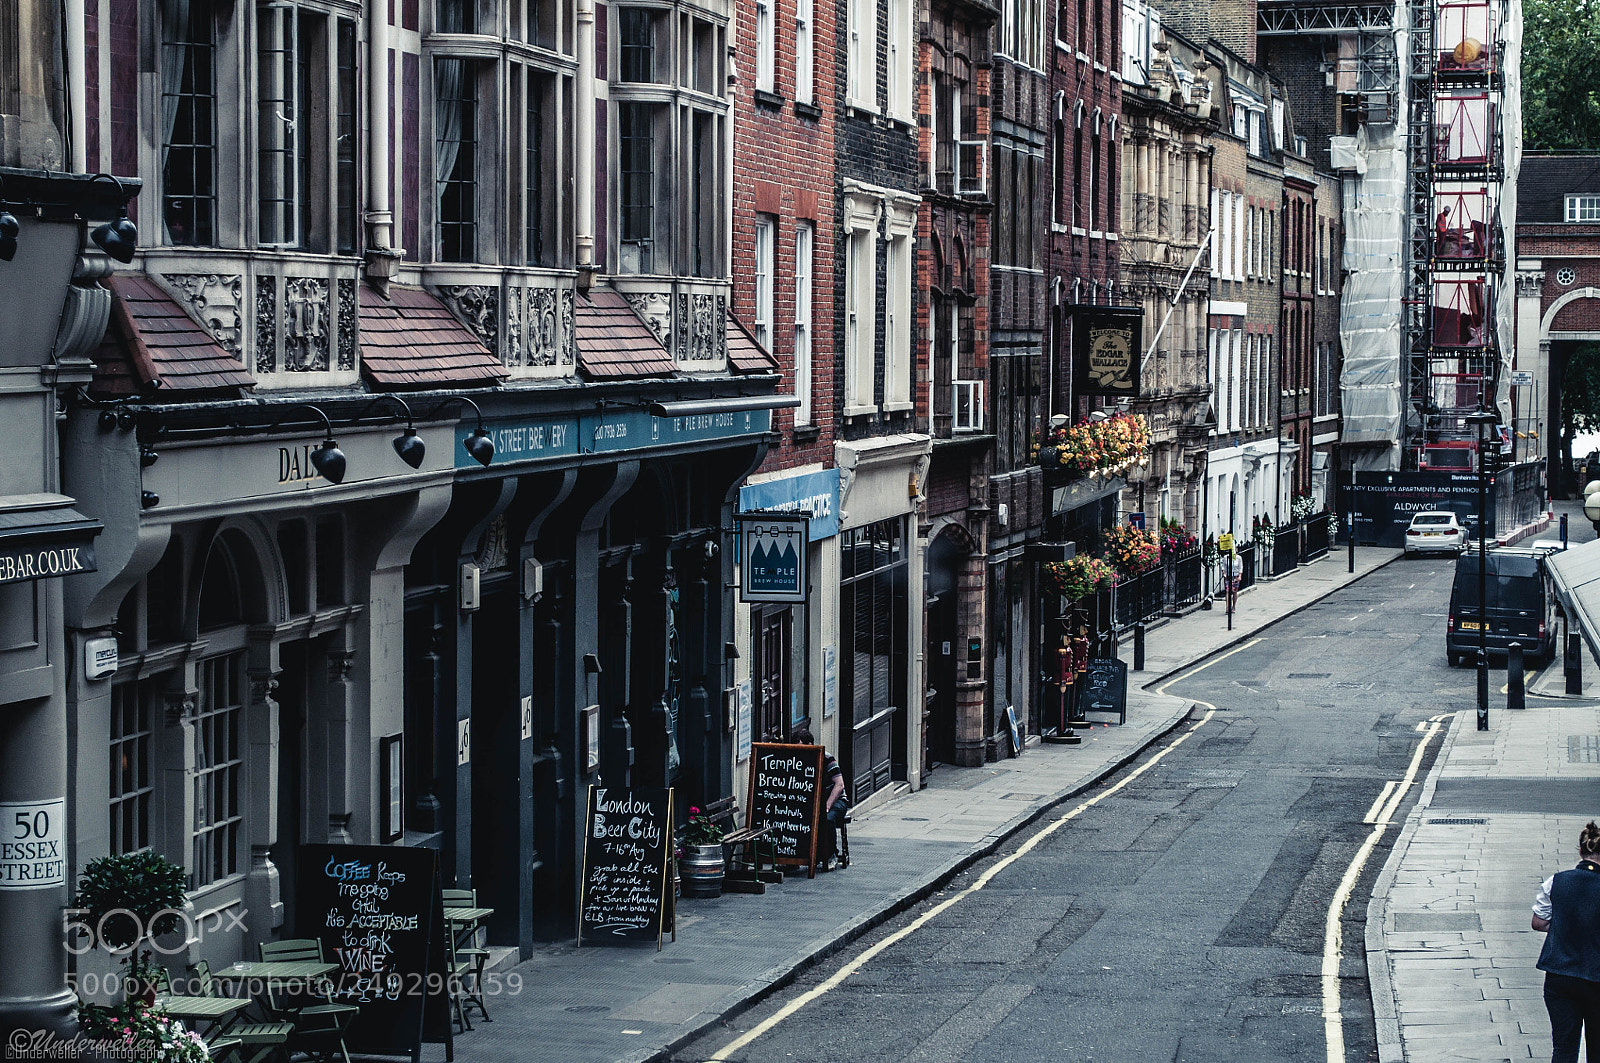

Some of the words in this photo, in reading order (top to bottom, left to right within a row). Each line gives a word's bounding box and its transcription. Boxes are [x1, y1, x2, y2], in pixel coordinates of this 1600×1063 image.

[1092, 358, 1128, 367] WALLACE
[1096, 349, 1124, 358] EDGAR
[673, 416, 696, 432] TEMPLE
[698, 414, 713, 431] BREW
[716, 412, 734, 428] HOUSE
[500, 428, 527, 454] STREET
[528, 424, 567, 450] BREWERY
[1394, 502, 1437, 511] ALDWYCH
[754, 567, 795, 576] TEMPLE
[522, 698, 531, 735] 46
[459, 722, 468, 761] 46
[760, 754, 803, 772] Temple
[758, 772, 786, 787] Brew
[788, 775, 814, 792] House
[596, 788, 654, 816] London
[765, 804, 770, 814] 6
[14, 810, 50, 840] 50
[593, 813, 626, 838] Beer
[628, 816, 660, 848] City
[763, 820, 770, 828] 16
[1, 840, 58, 860] ESSEX
[628, 842, 645, 862] Aug
[324, 854, 372, 881] COFFEE
[592, 864, 618, 877] grab
[620, 862, 640, 873] all
[642, 864, 659, 875] the
[338, 882, 359, 897] me
[360, 882, 389, 900] going
[346, 912, 418, 931] ACCEPTABLE
[342, 930, 358, 947] to
[360, 930, 394, 954] drink
[332, 948, 388, 974] WINE
